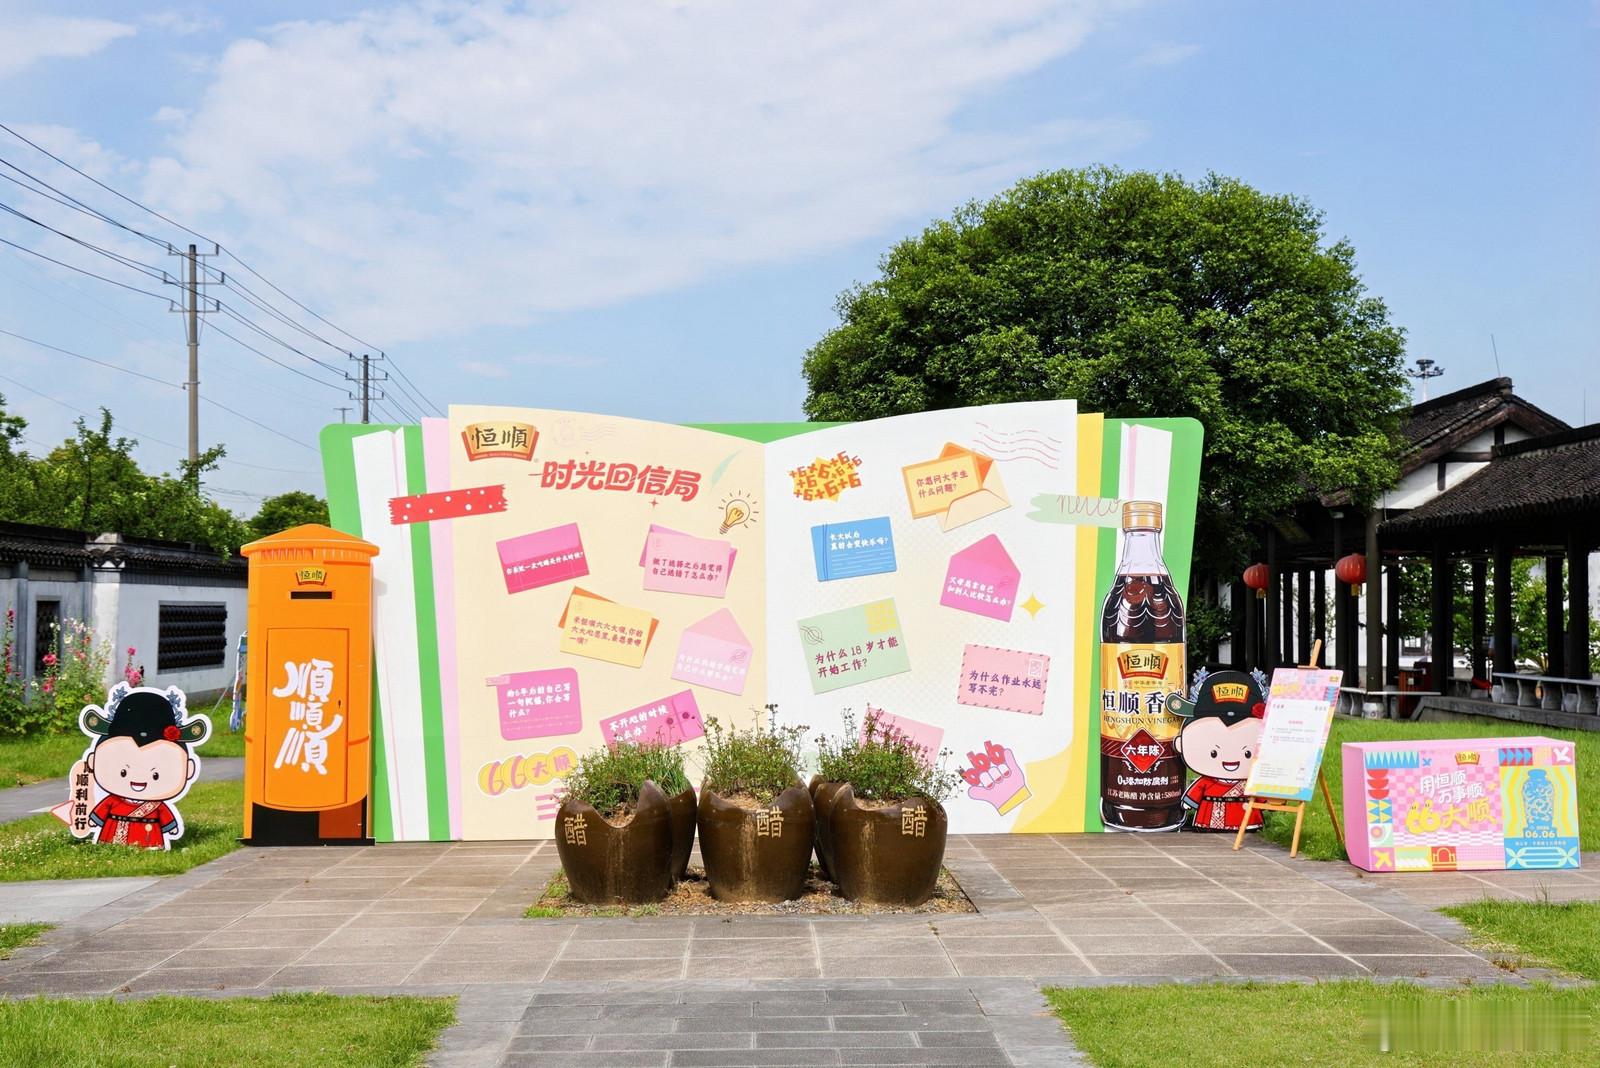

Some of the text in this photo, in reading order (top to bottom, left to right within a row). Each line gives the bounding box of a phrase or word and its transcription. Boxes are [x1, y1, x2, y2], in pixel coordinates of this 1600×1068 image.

[540, 459, 702, 502] 时光回信局
[918, 483, 957, 498] 什么问题?
[818, 658, 868, 678] 开始工作?
[968, 683, 1005, 697] 写不完?
[1102, 689, 1183, 715] 恒顺香
[609, 704, 669, 731] 不开心的时候
[1125, 745, 1160, 756] 六年陈
[1420, 770, 1466, 798] 用恒顺
[74, 774, 89, 830] 顺利前行
[564, 813, 588, 846] 醋
[756, 805, 784, 838] 醋
[901, 805, 928, 838] 醋
[1525, 830, 1555, 838] 06.06
